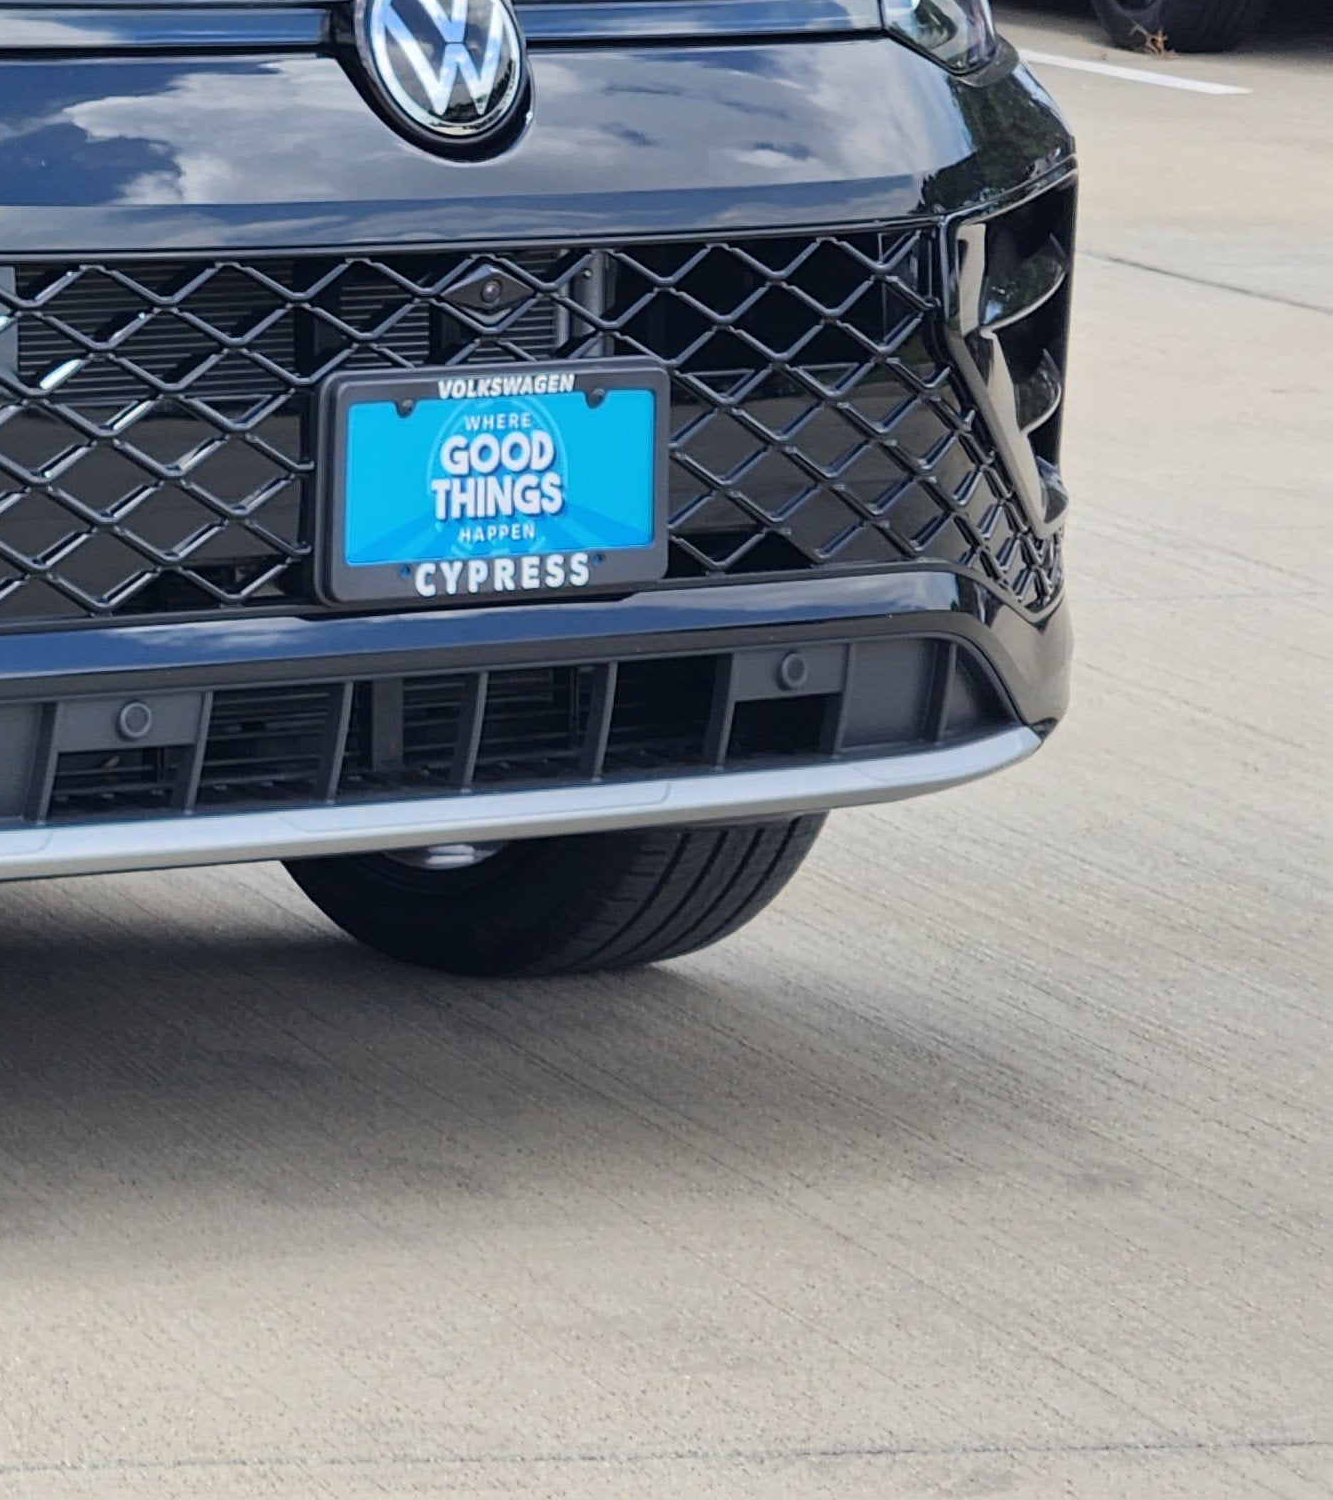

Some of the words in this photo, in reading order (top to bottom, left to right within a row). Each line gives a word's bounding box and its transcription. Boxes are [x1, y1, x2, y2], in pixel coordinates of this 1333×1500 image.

[437, 373, 575, 400] VOLKSWAGEN
[464, 412, 534, 431] WHERE
[439, 430, 556, 476] GOOD
[431, 473, 565, 521] THINGS
[458, 522, 537, 543] HAPPEN
[414, 552, 591, 598] CYPRESS
